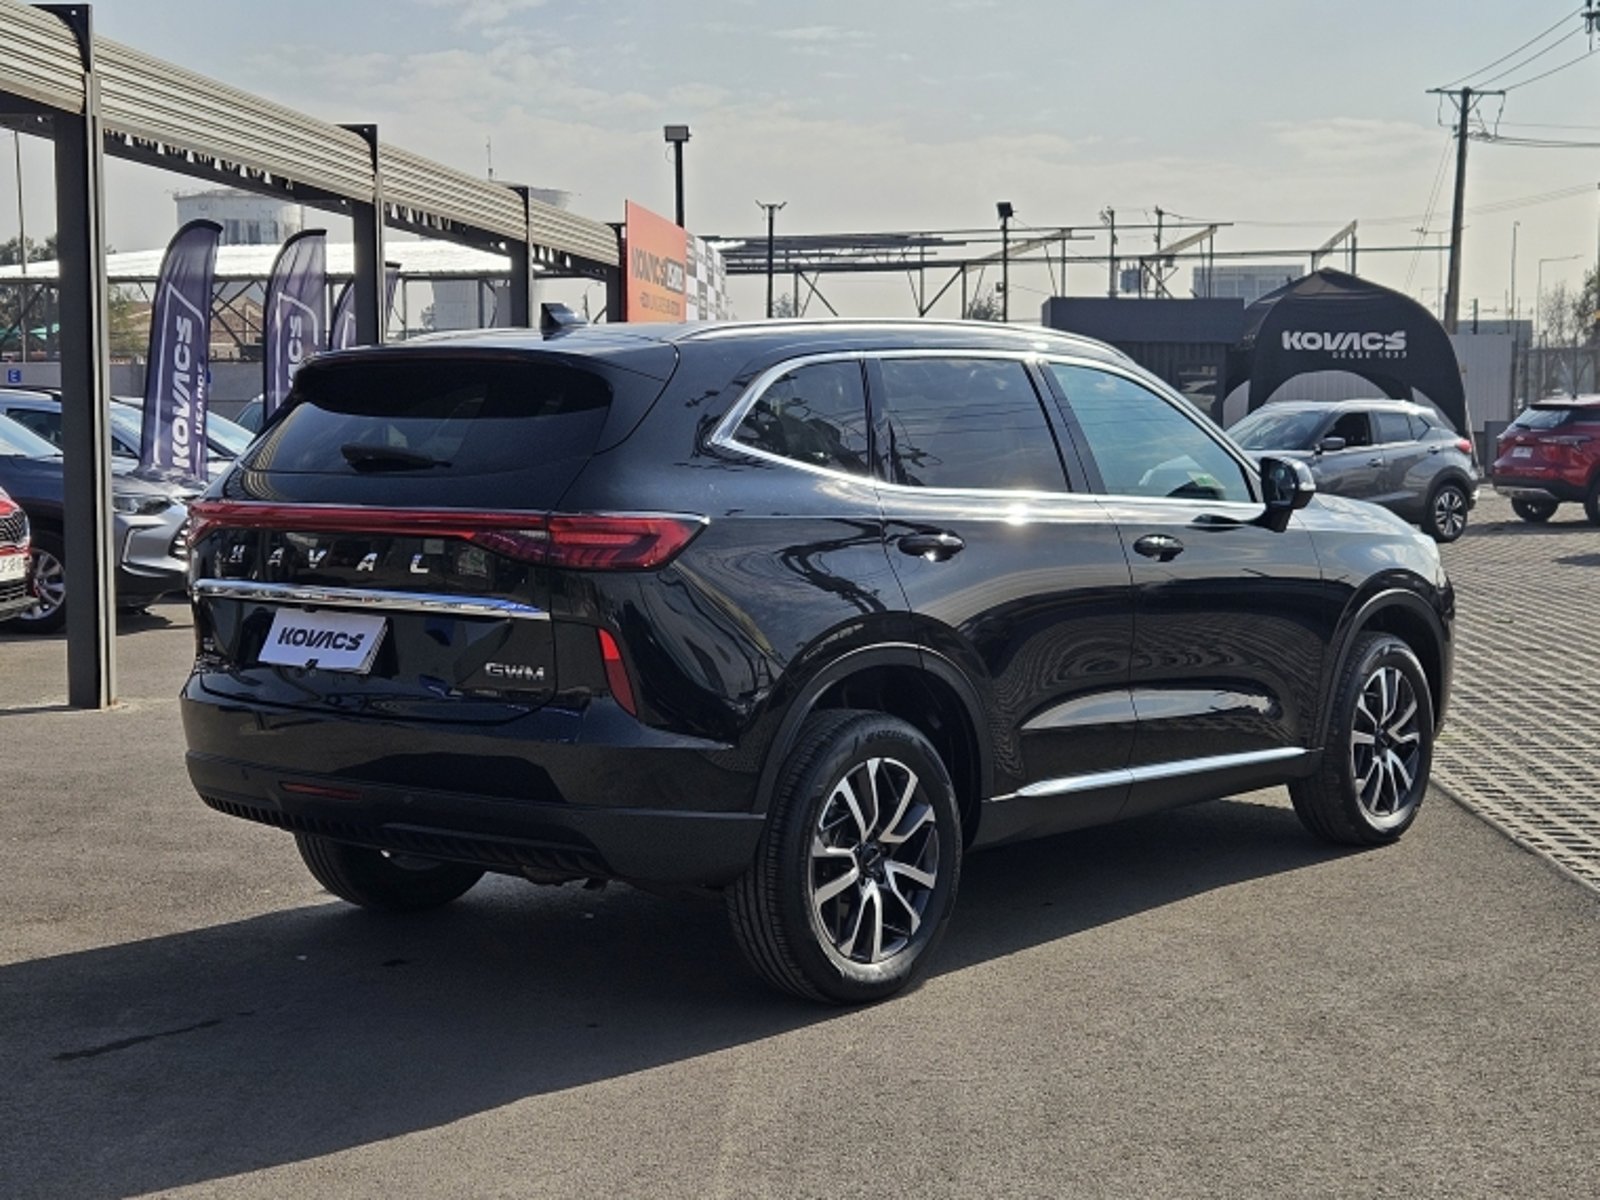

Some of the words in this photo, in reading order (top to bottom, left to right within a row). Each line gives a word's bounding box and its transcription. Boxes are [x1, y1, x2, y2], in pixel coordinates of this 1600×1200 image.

[1281, 330, 1407, 350] KOVACS
[172, 315, 192, 468] KOVACS
[230, 544, 429, 574] HAVAL
[278, 626, 365, 651] KOVACS
[485, 662, 545, 681] GWM
